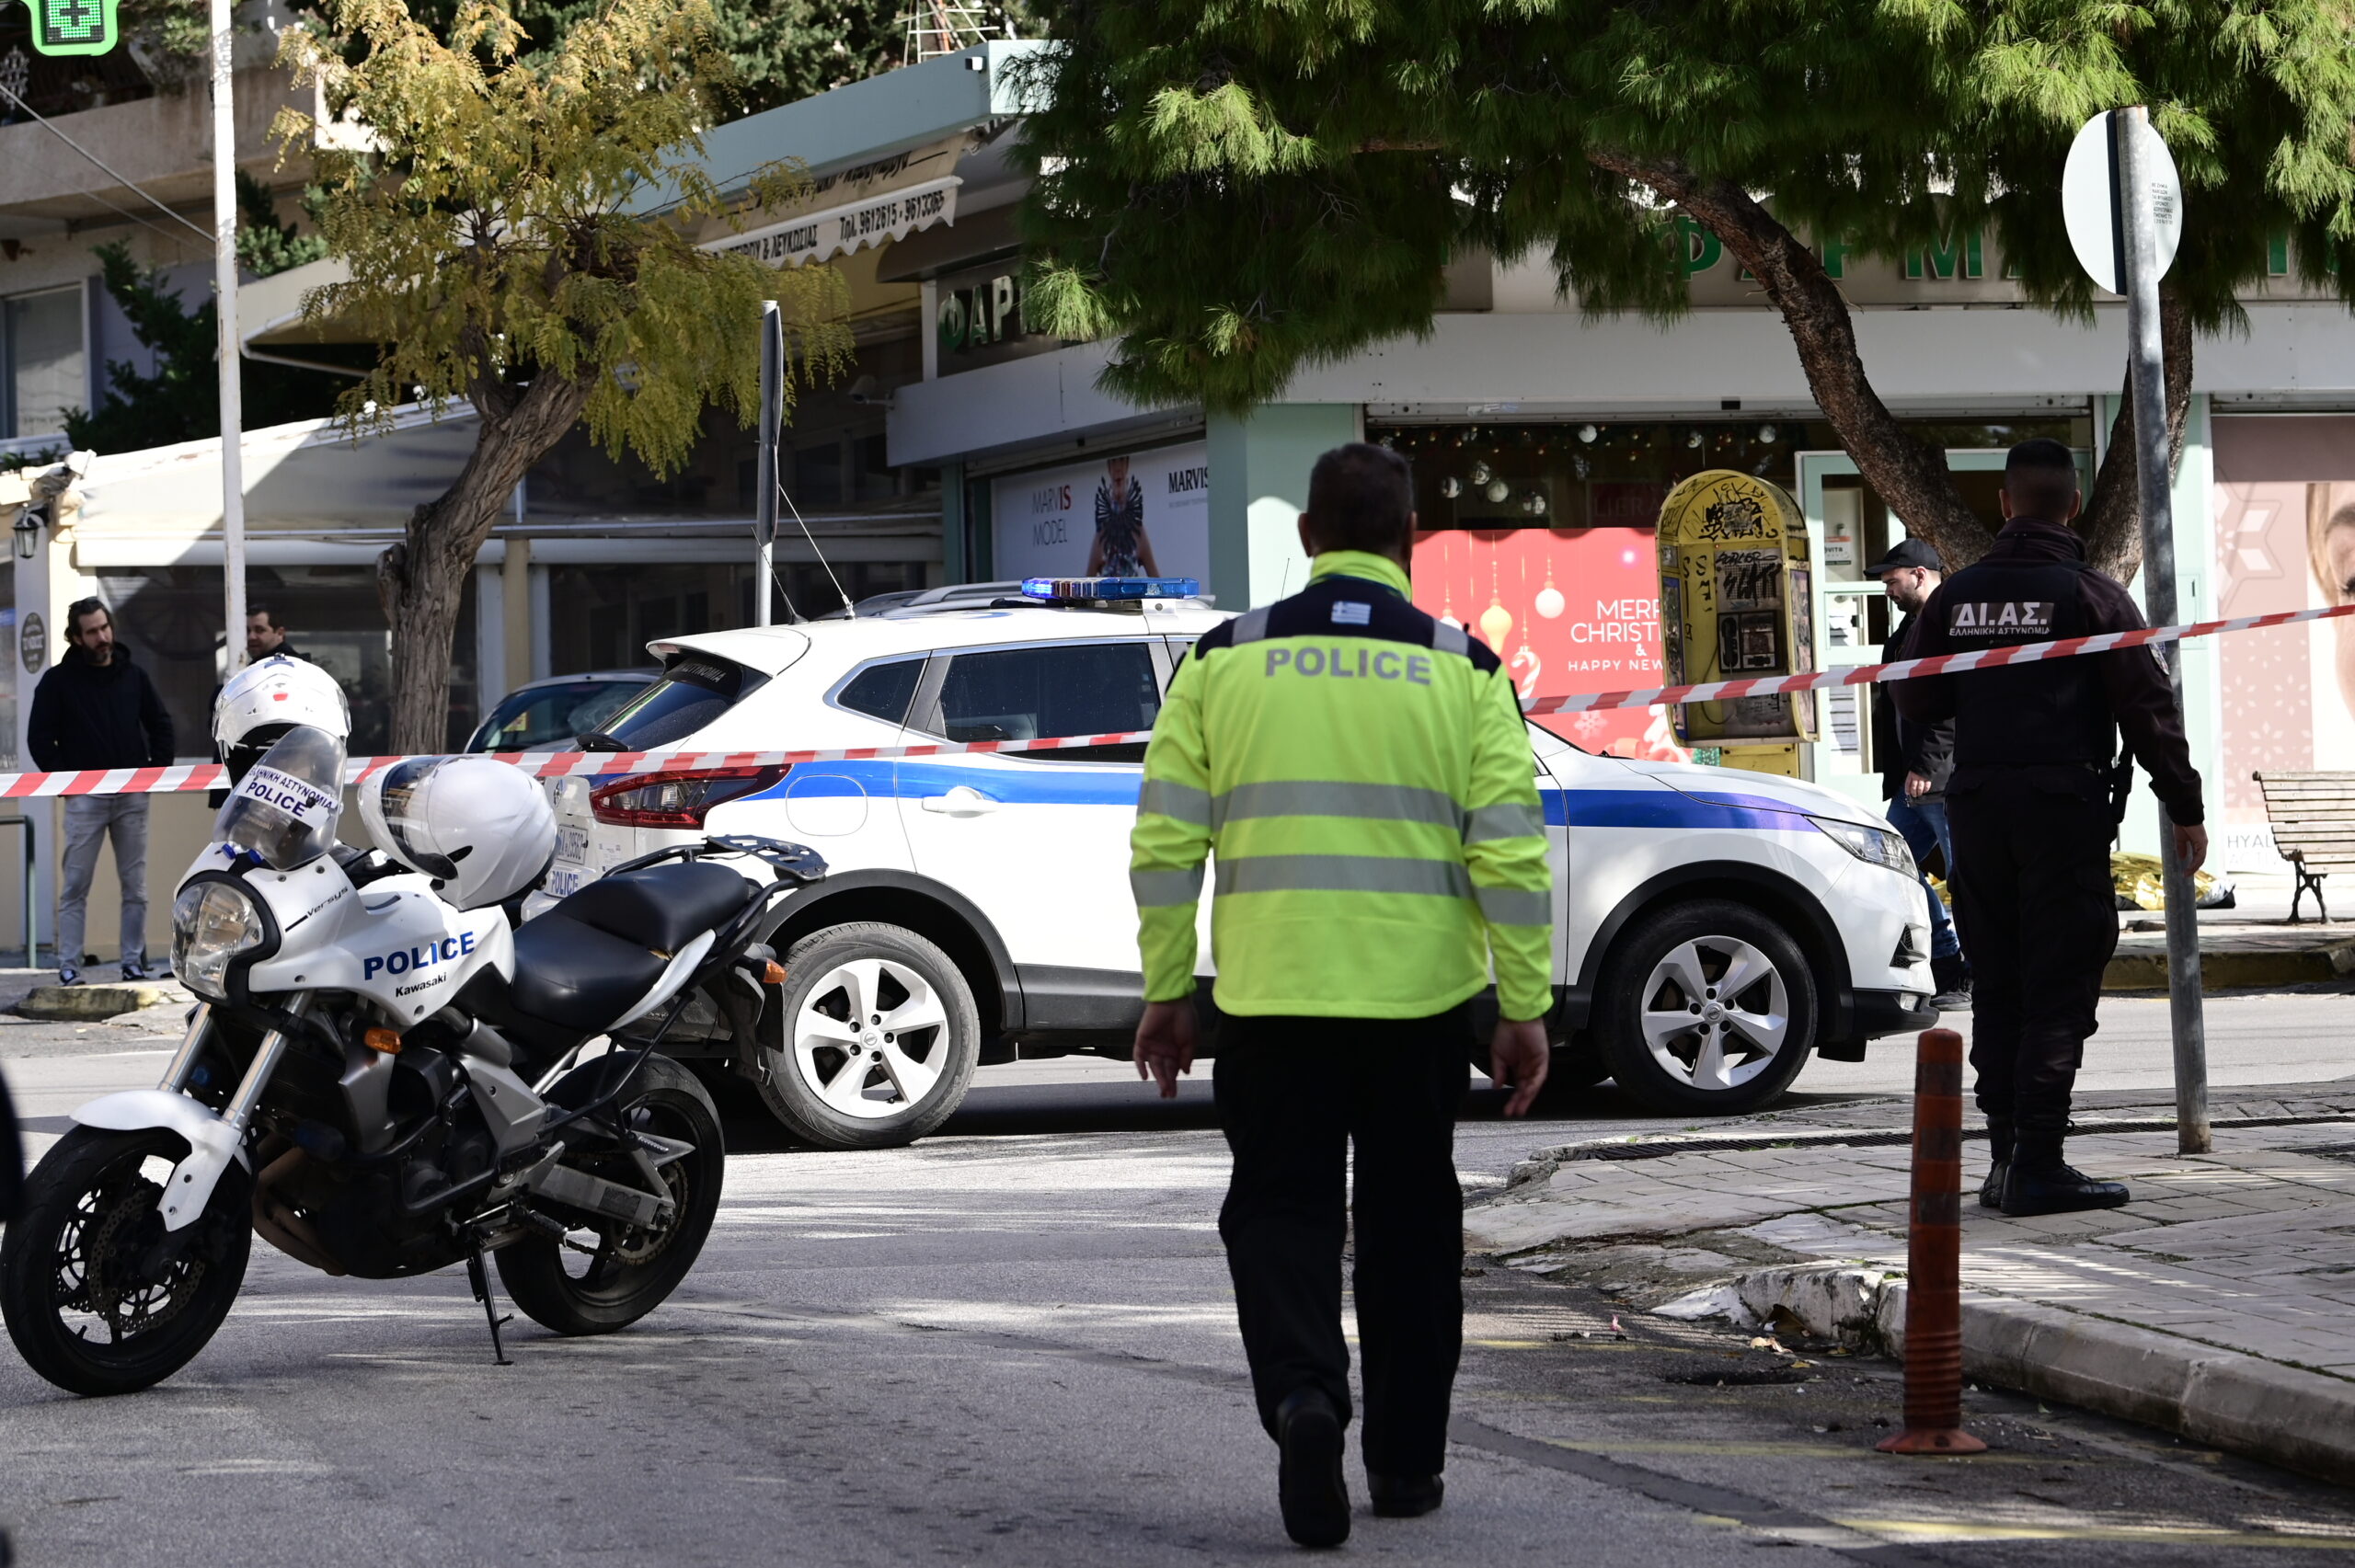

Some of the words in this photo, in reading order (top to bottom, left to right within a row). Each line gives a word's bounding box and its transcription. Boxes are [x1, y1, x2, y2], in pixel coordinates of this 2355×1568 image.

[859, 202, 898, 235] 9612615
[1168, 465, 1209, 494] MARVIS
[1031, 485, 1073, 514] MARVIS
[1032, 519, 1068, 546] MODEL
[1955, 601, 2048, 626] ΔΙ.ΑΣ.
[1570, 622, 1662, 643] CHRIST
[1948, 627, 1995, 636] ΕΛΛΗΝΙΚΗ
[1997, 626, 2051, 635] ΑΣΤΥΝΟΜΙΑ
[1635, 643, 1648, 657] &
[1265, 647, 1432, 686] POLICE
[1568, 659, 1622, 671] HAPPY
[1628, 658, 1663, 670] NEW
[246, 782, 309, 818] POLICE
[280, 776, 333, 809] ΑΣΤΥΝΟΜΙΑ
[552, 870, 579, 897] POLICE
[306, 886, 349, 918] Versys
[363, 931, 476, 980] POLICE
[395, 971, 447, 998] Kawasaki
